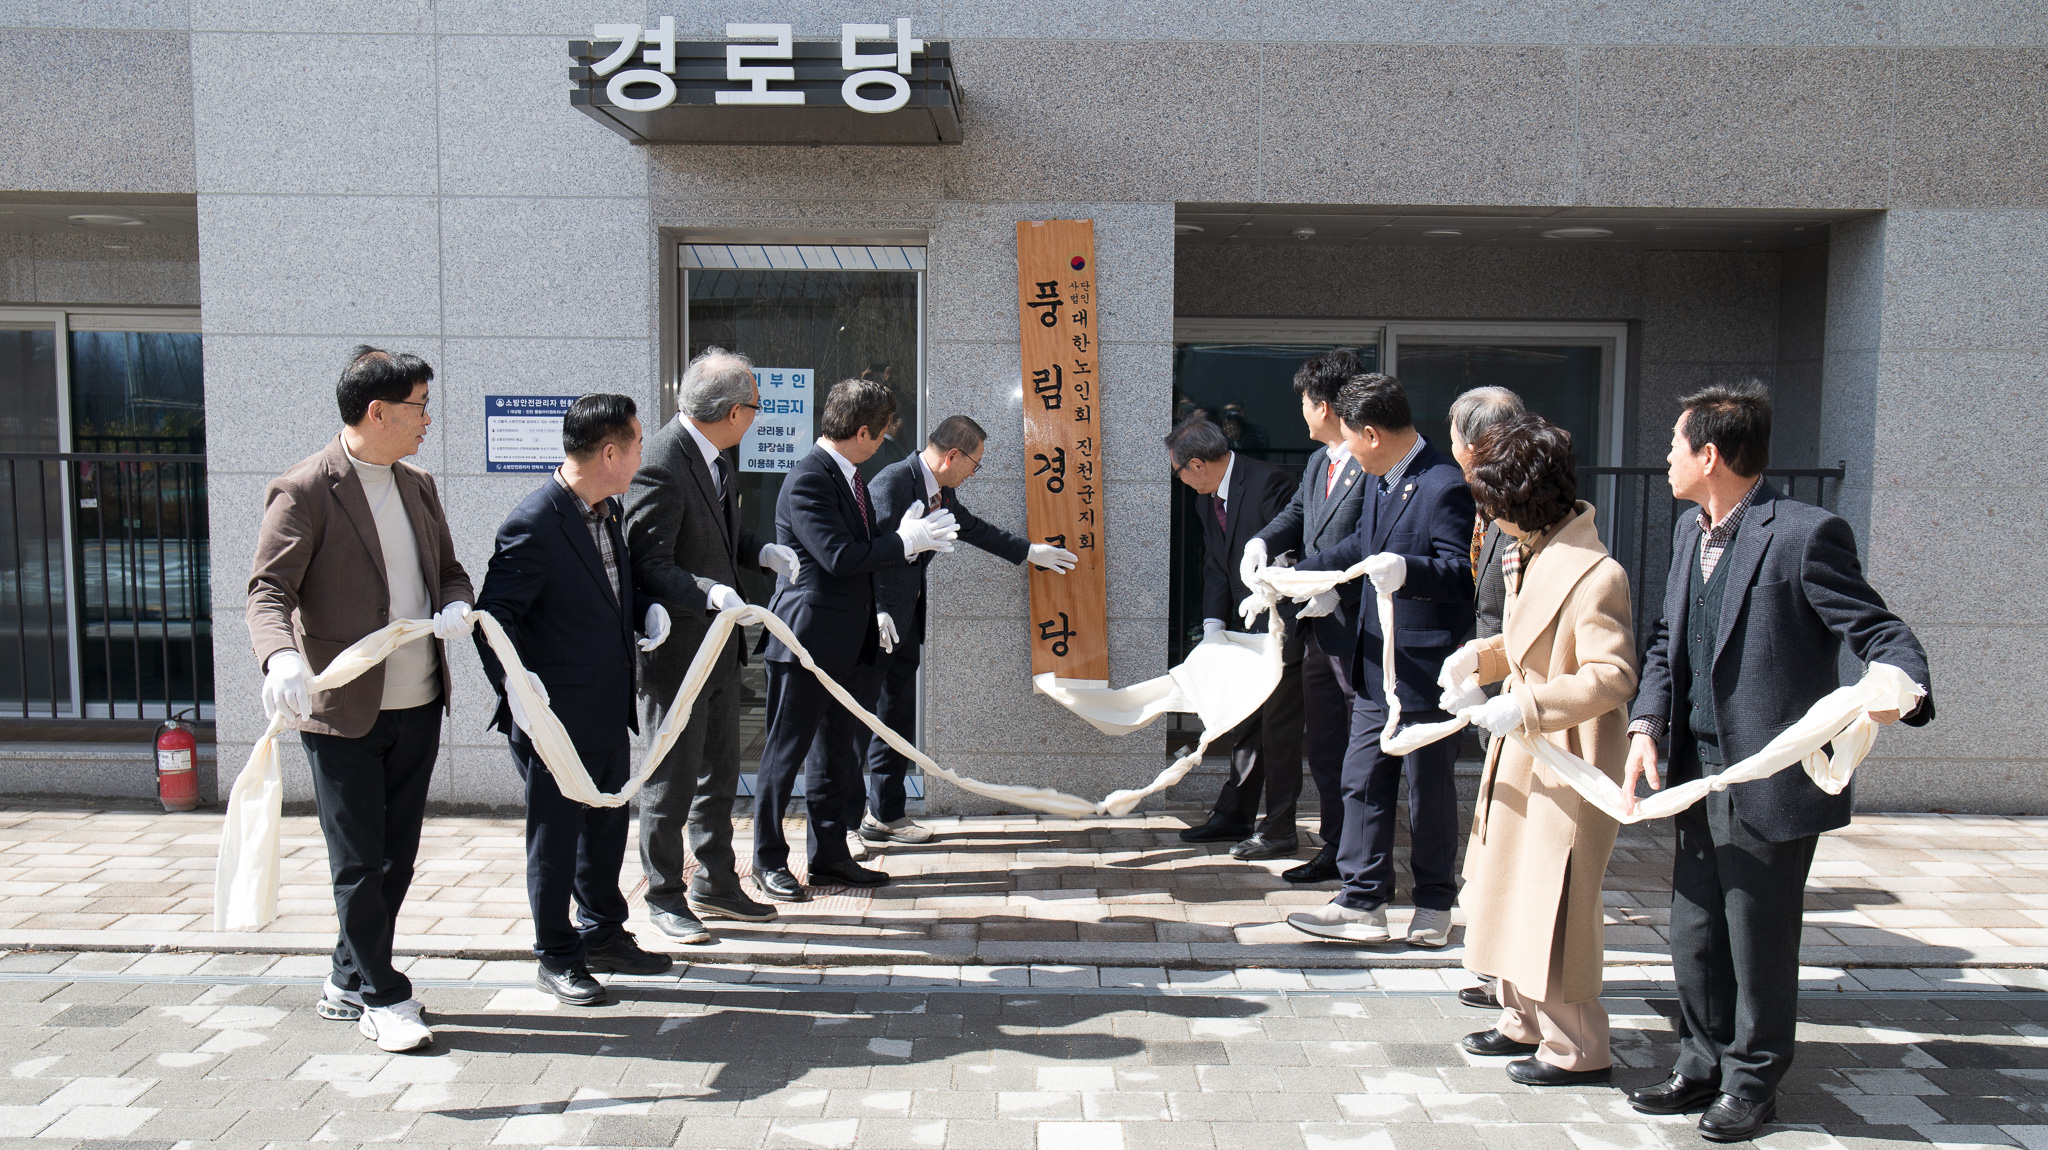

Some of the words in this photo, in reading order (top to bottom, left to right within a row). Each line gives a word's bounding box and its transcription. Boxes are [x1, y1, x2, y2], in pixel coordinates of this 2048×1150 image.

[590, 15, 925, 113] 경로당
[1071, 308, 1092, 424] 대한노인회
[505, 398, 558, 408] 소방안전관리자
[758, 399, 804, 414] 입금지
[757, 425, 784, 436] 관리동
[786, 426, 796, 436] 내
[757, 442, 795, 453] 화장실을
[748, 458, 775, 469] 이용해
[777, 459, 801, 469] 주세
[1075, 436, 1095, 551] 진천군지회
